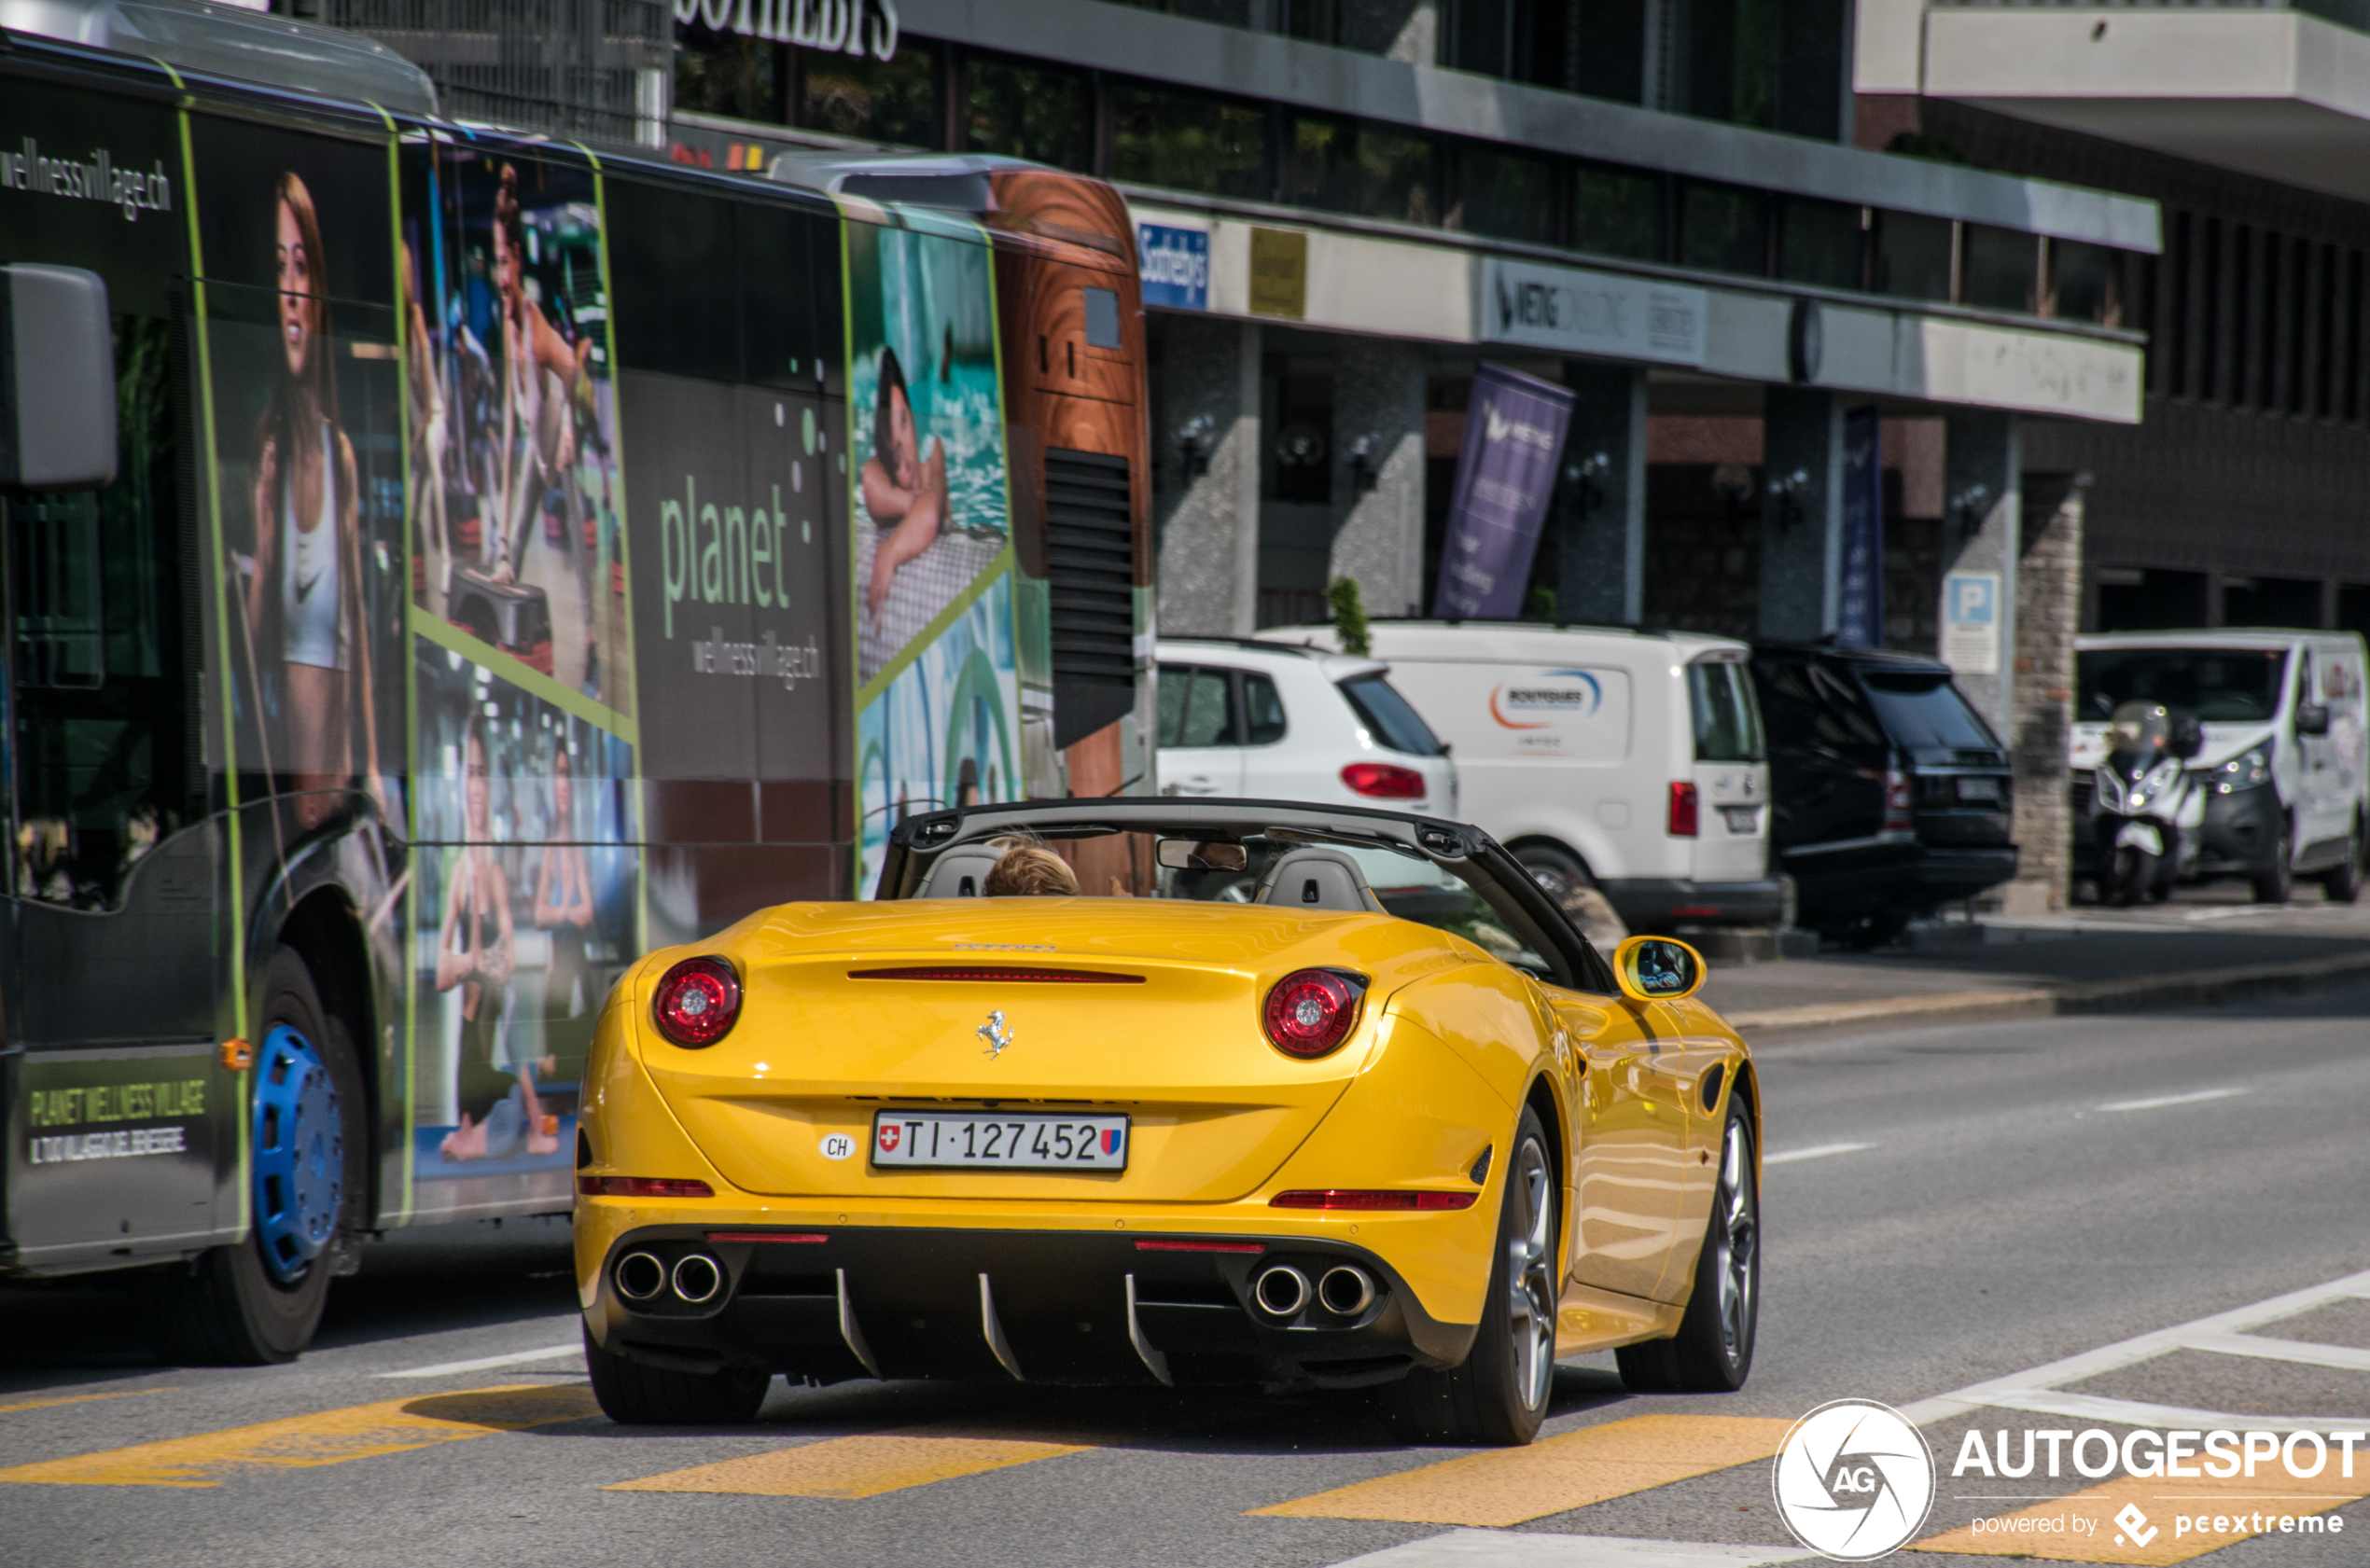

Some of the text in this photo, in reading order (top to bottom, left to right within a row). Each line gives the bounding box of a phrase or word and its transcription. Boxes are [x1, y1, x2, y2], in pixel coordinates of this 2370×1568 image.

[660, 474, 789, 640] planet
[1960, 586, 1985, 620] P
[827, 1137, 848, 1158] CH
